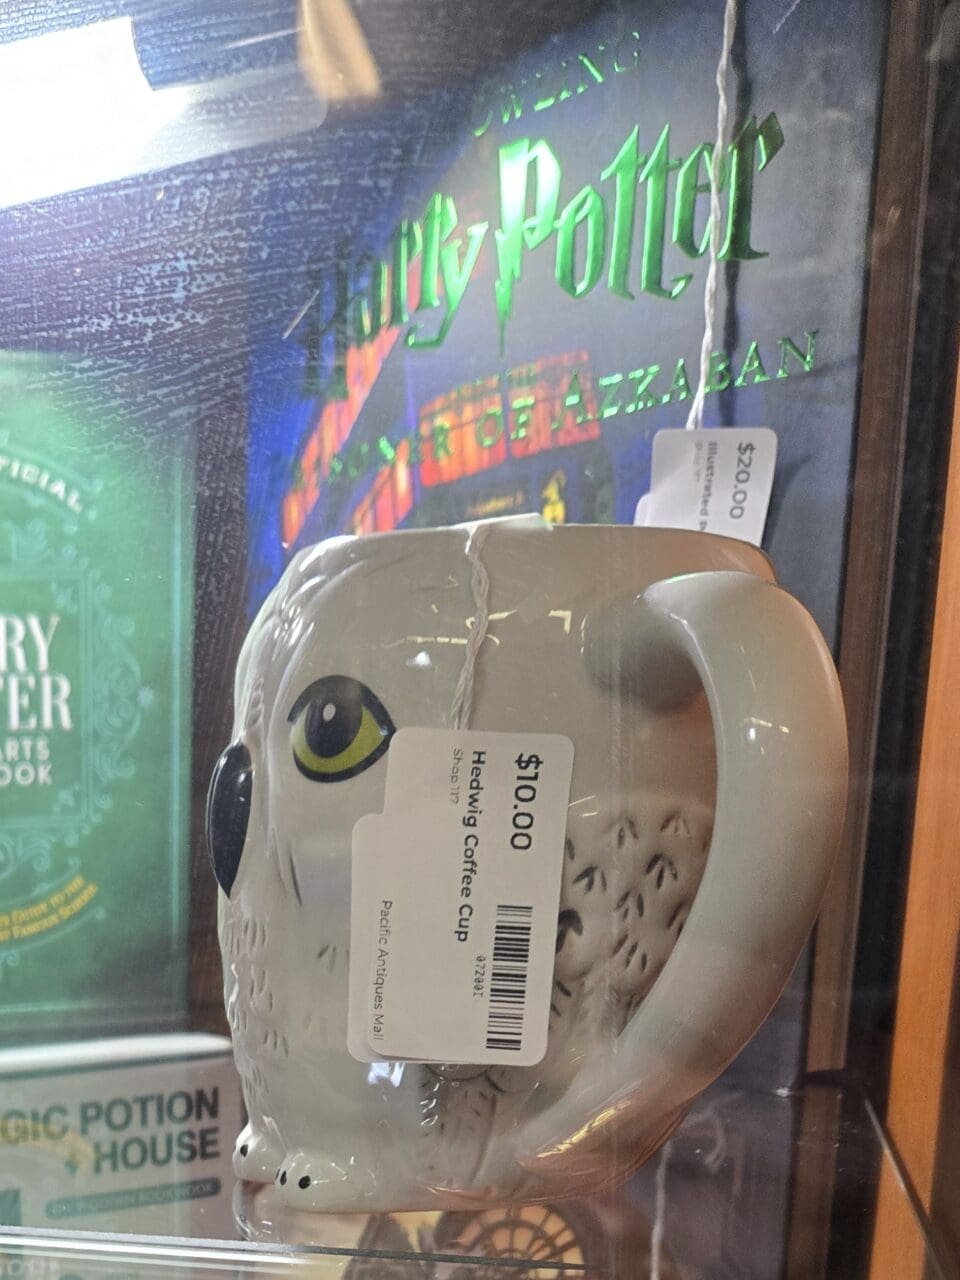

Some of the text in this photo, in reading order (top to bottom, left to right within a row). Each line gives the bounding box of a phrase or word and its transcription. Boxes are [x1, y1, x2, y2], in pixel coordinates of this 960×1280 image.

[495, 112, 785, 358] Potter
[476, 396, 536, 448] OF
[551, 329, 820, 430] AZKABAN
[730, 442, 756, 520] $20.00
[450, 748, 464, 784] Shop
[510, 752, 544, 851] $10.00
[453, 750, 487, 943] Hedwig Coffee Cup
[373, 900, 393, 1042] Pacific Antiques Mall
[79, 1086, 221, 1136] POTION
[93, 1127, 221, 1176] HOUSE
